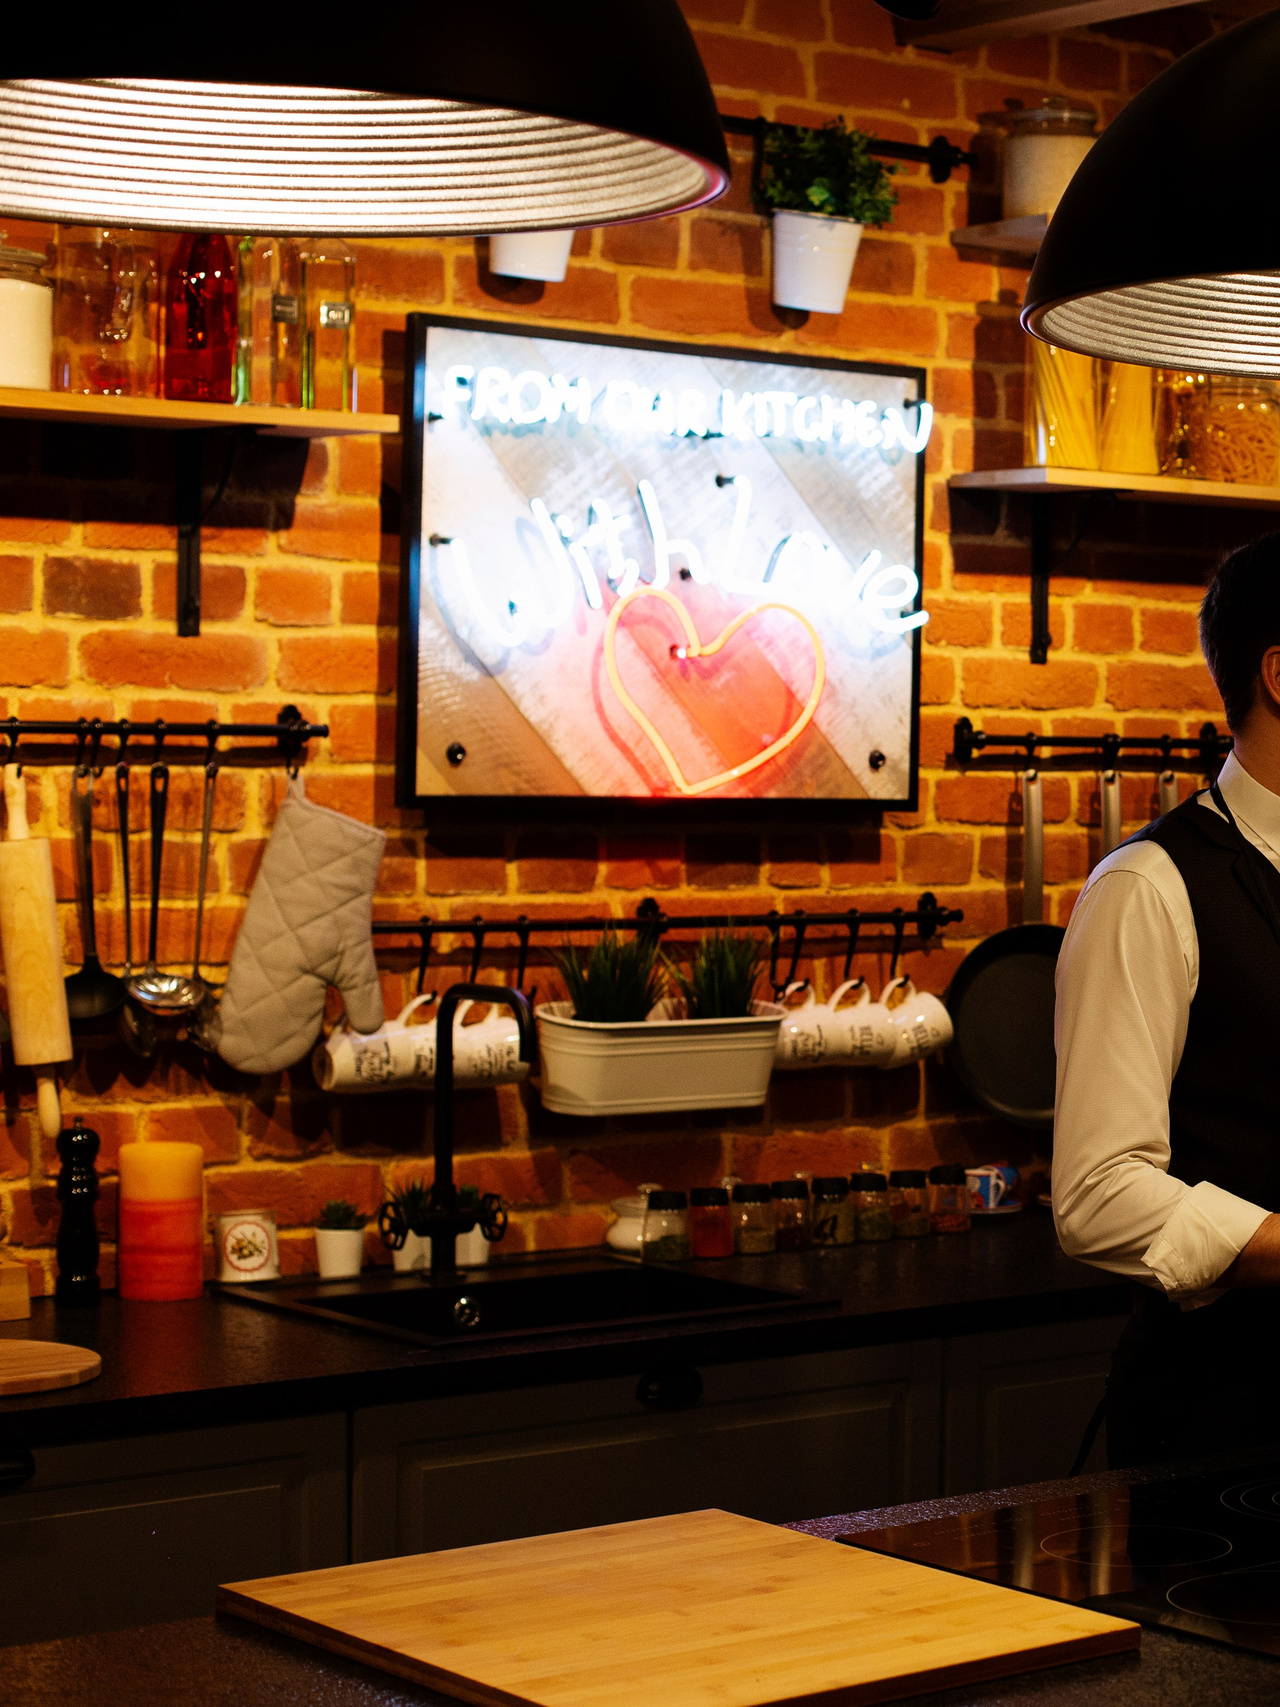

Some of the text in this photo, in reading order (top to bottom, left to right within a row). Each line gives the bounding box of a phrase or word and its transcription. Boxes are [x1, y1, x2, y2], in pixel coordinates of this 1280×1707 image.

[441, 364, 934, 454] FROM OUR KITCHEN
[449, 474, 930, 647] With Love
